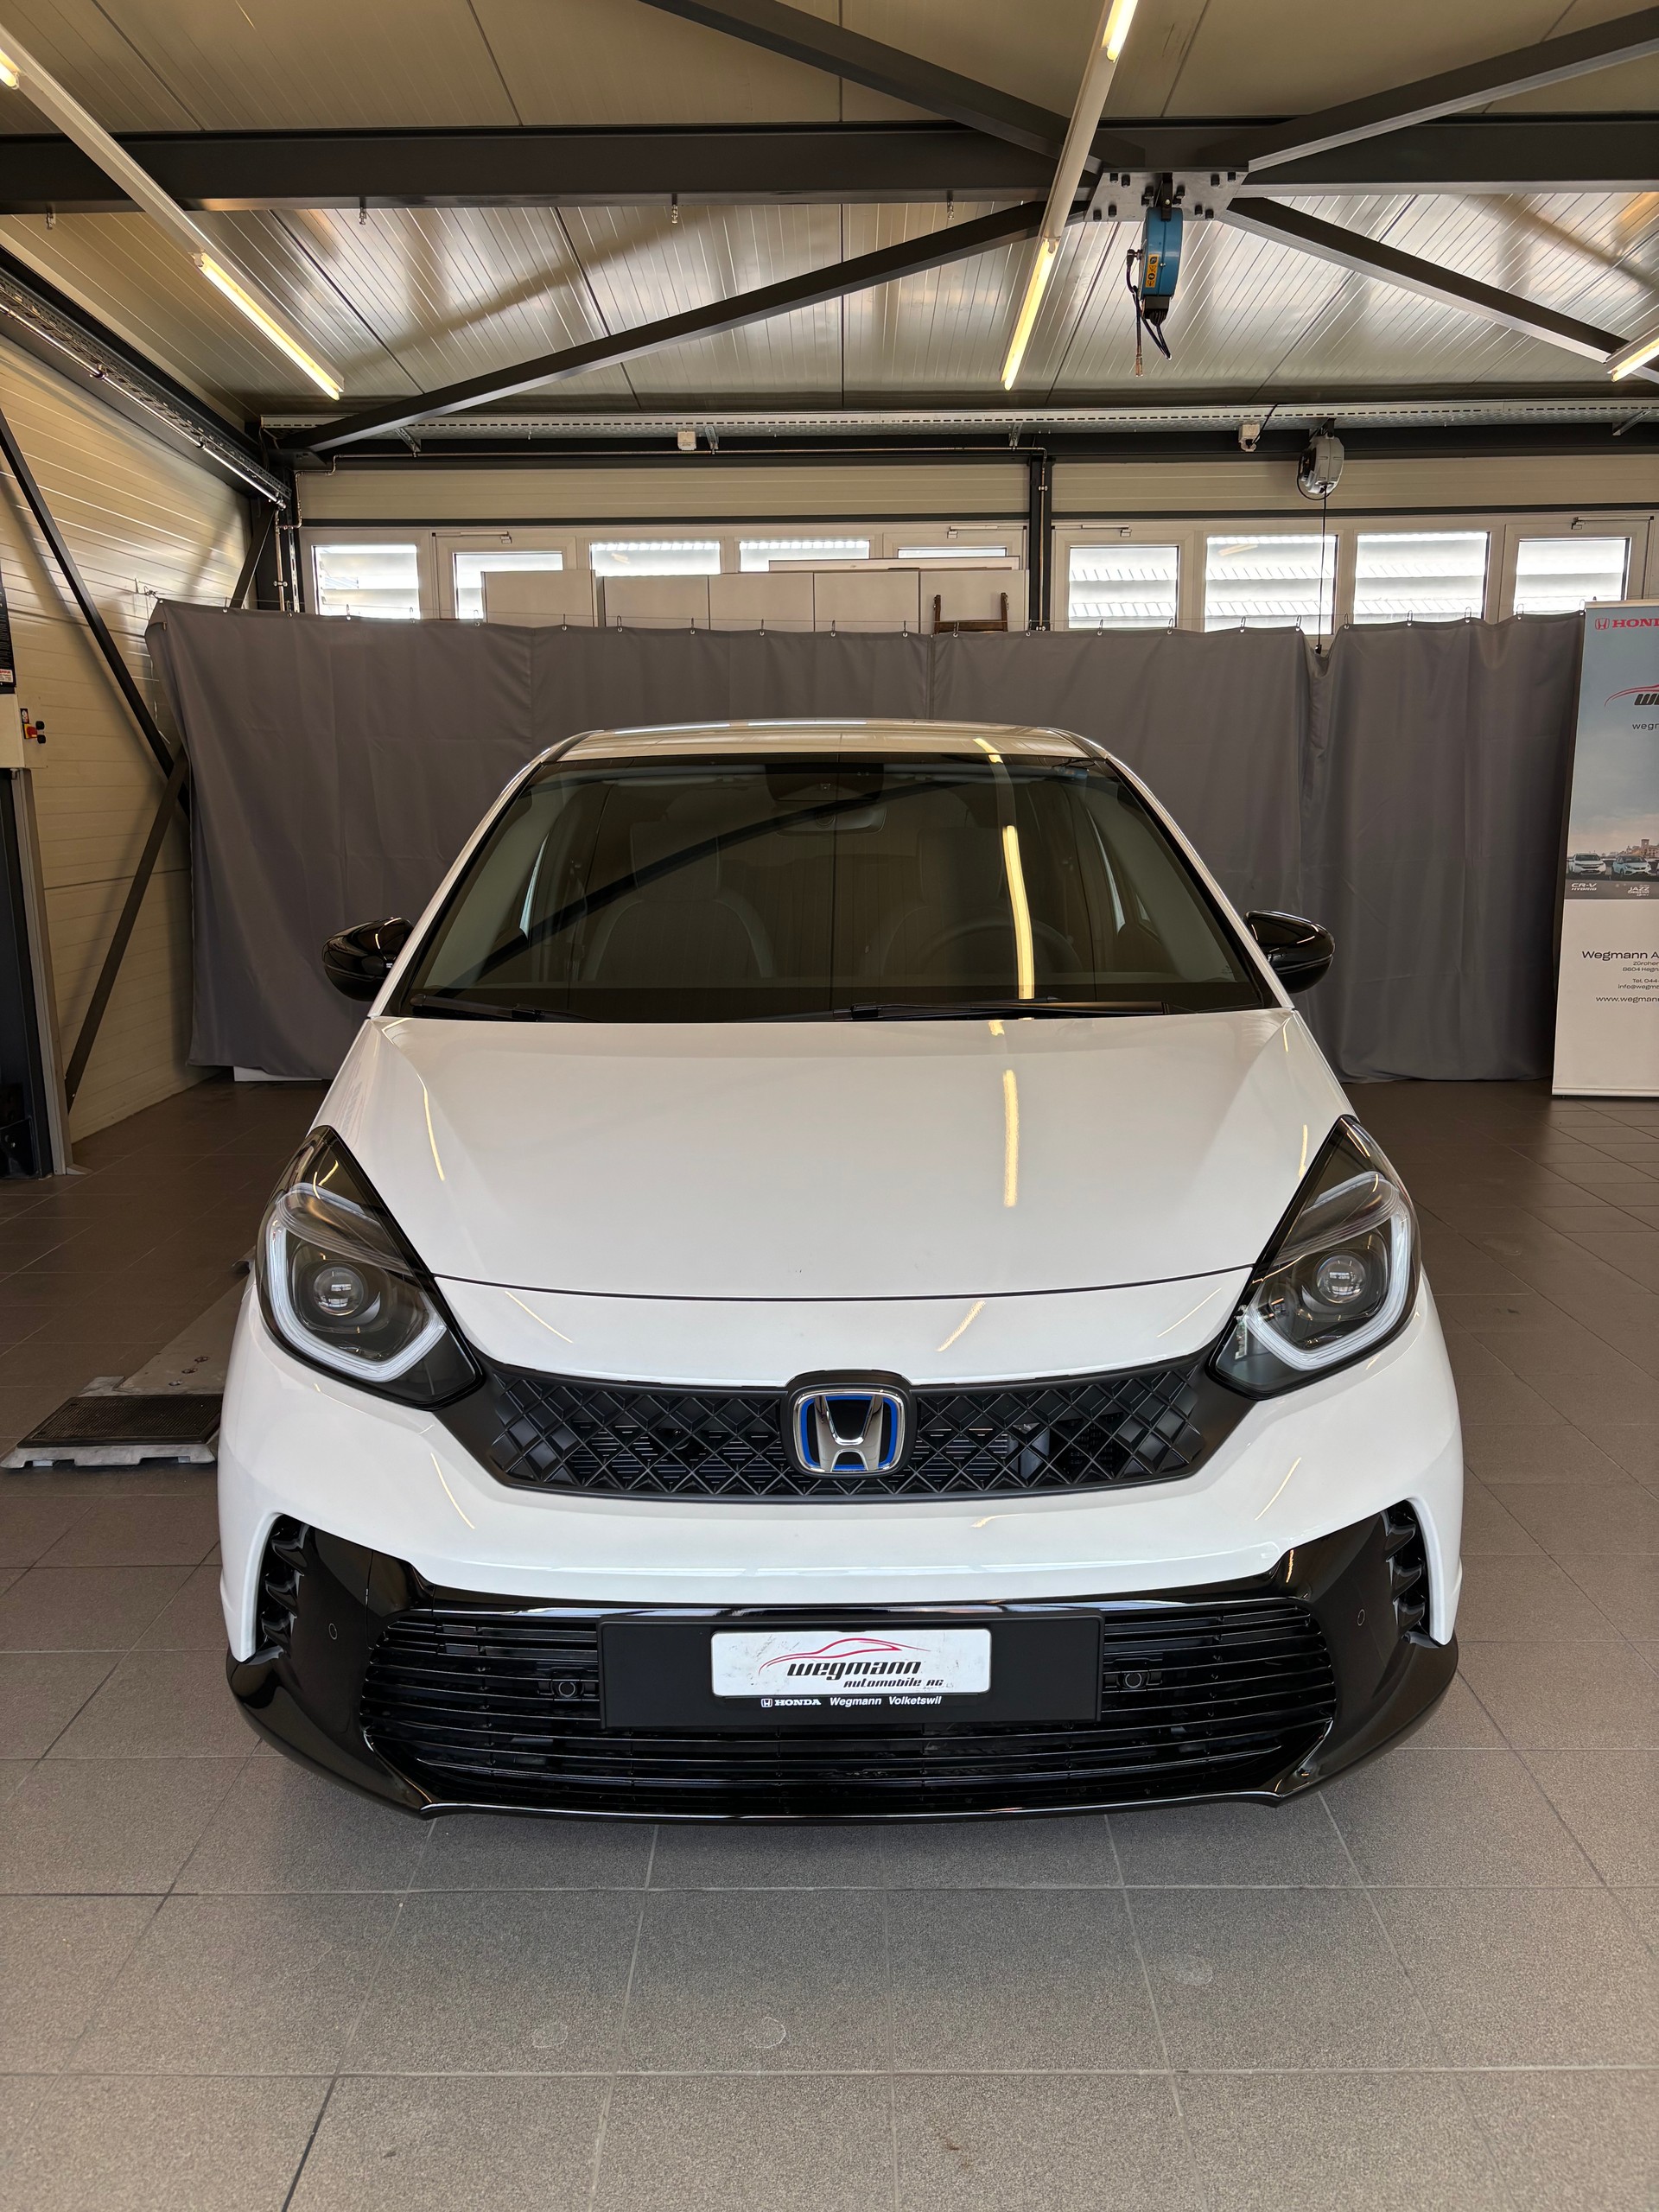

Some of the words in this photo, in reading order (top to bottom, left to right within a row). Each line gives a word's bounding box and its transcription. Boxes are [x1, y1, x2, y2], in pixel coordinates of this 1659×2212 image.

[1582, 950, 1648, 961] Wegmann
[787, 1661, 922, 1681] wegmann
[843, 1677, 922, 1688] automobile
[830, 1697, 881, 1707] Wegmann
[888, 1695, 942, 1706] Volketswil
